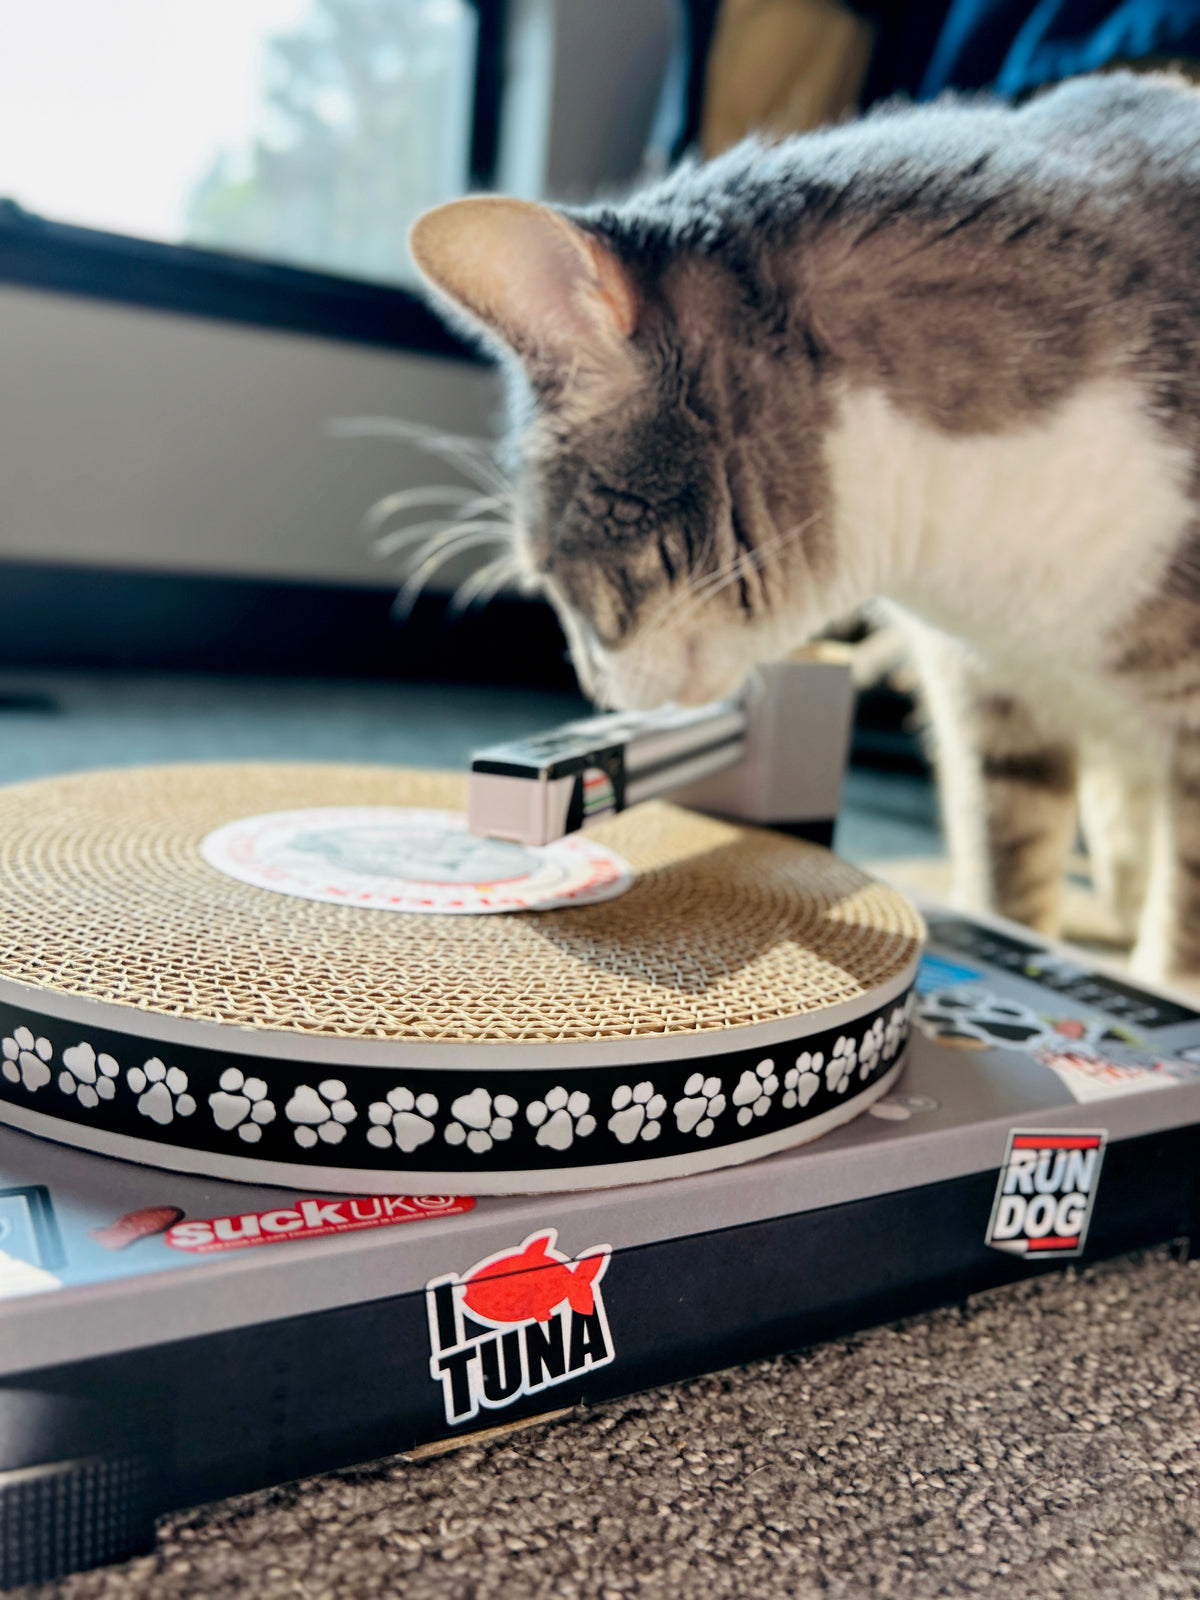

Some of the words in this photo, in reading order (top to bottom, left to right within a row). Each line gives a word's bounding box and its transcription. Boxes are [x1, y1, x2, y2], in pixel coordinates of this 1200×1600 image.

[1004, 1149, 1099, 1194] RUN
[992, 1192, 1087, 1239] DOG
[434, 1282, 457, 1351] I
[438, 1301, 609, 1418] TUNA
